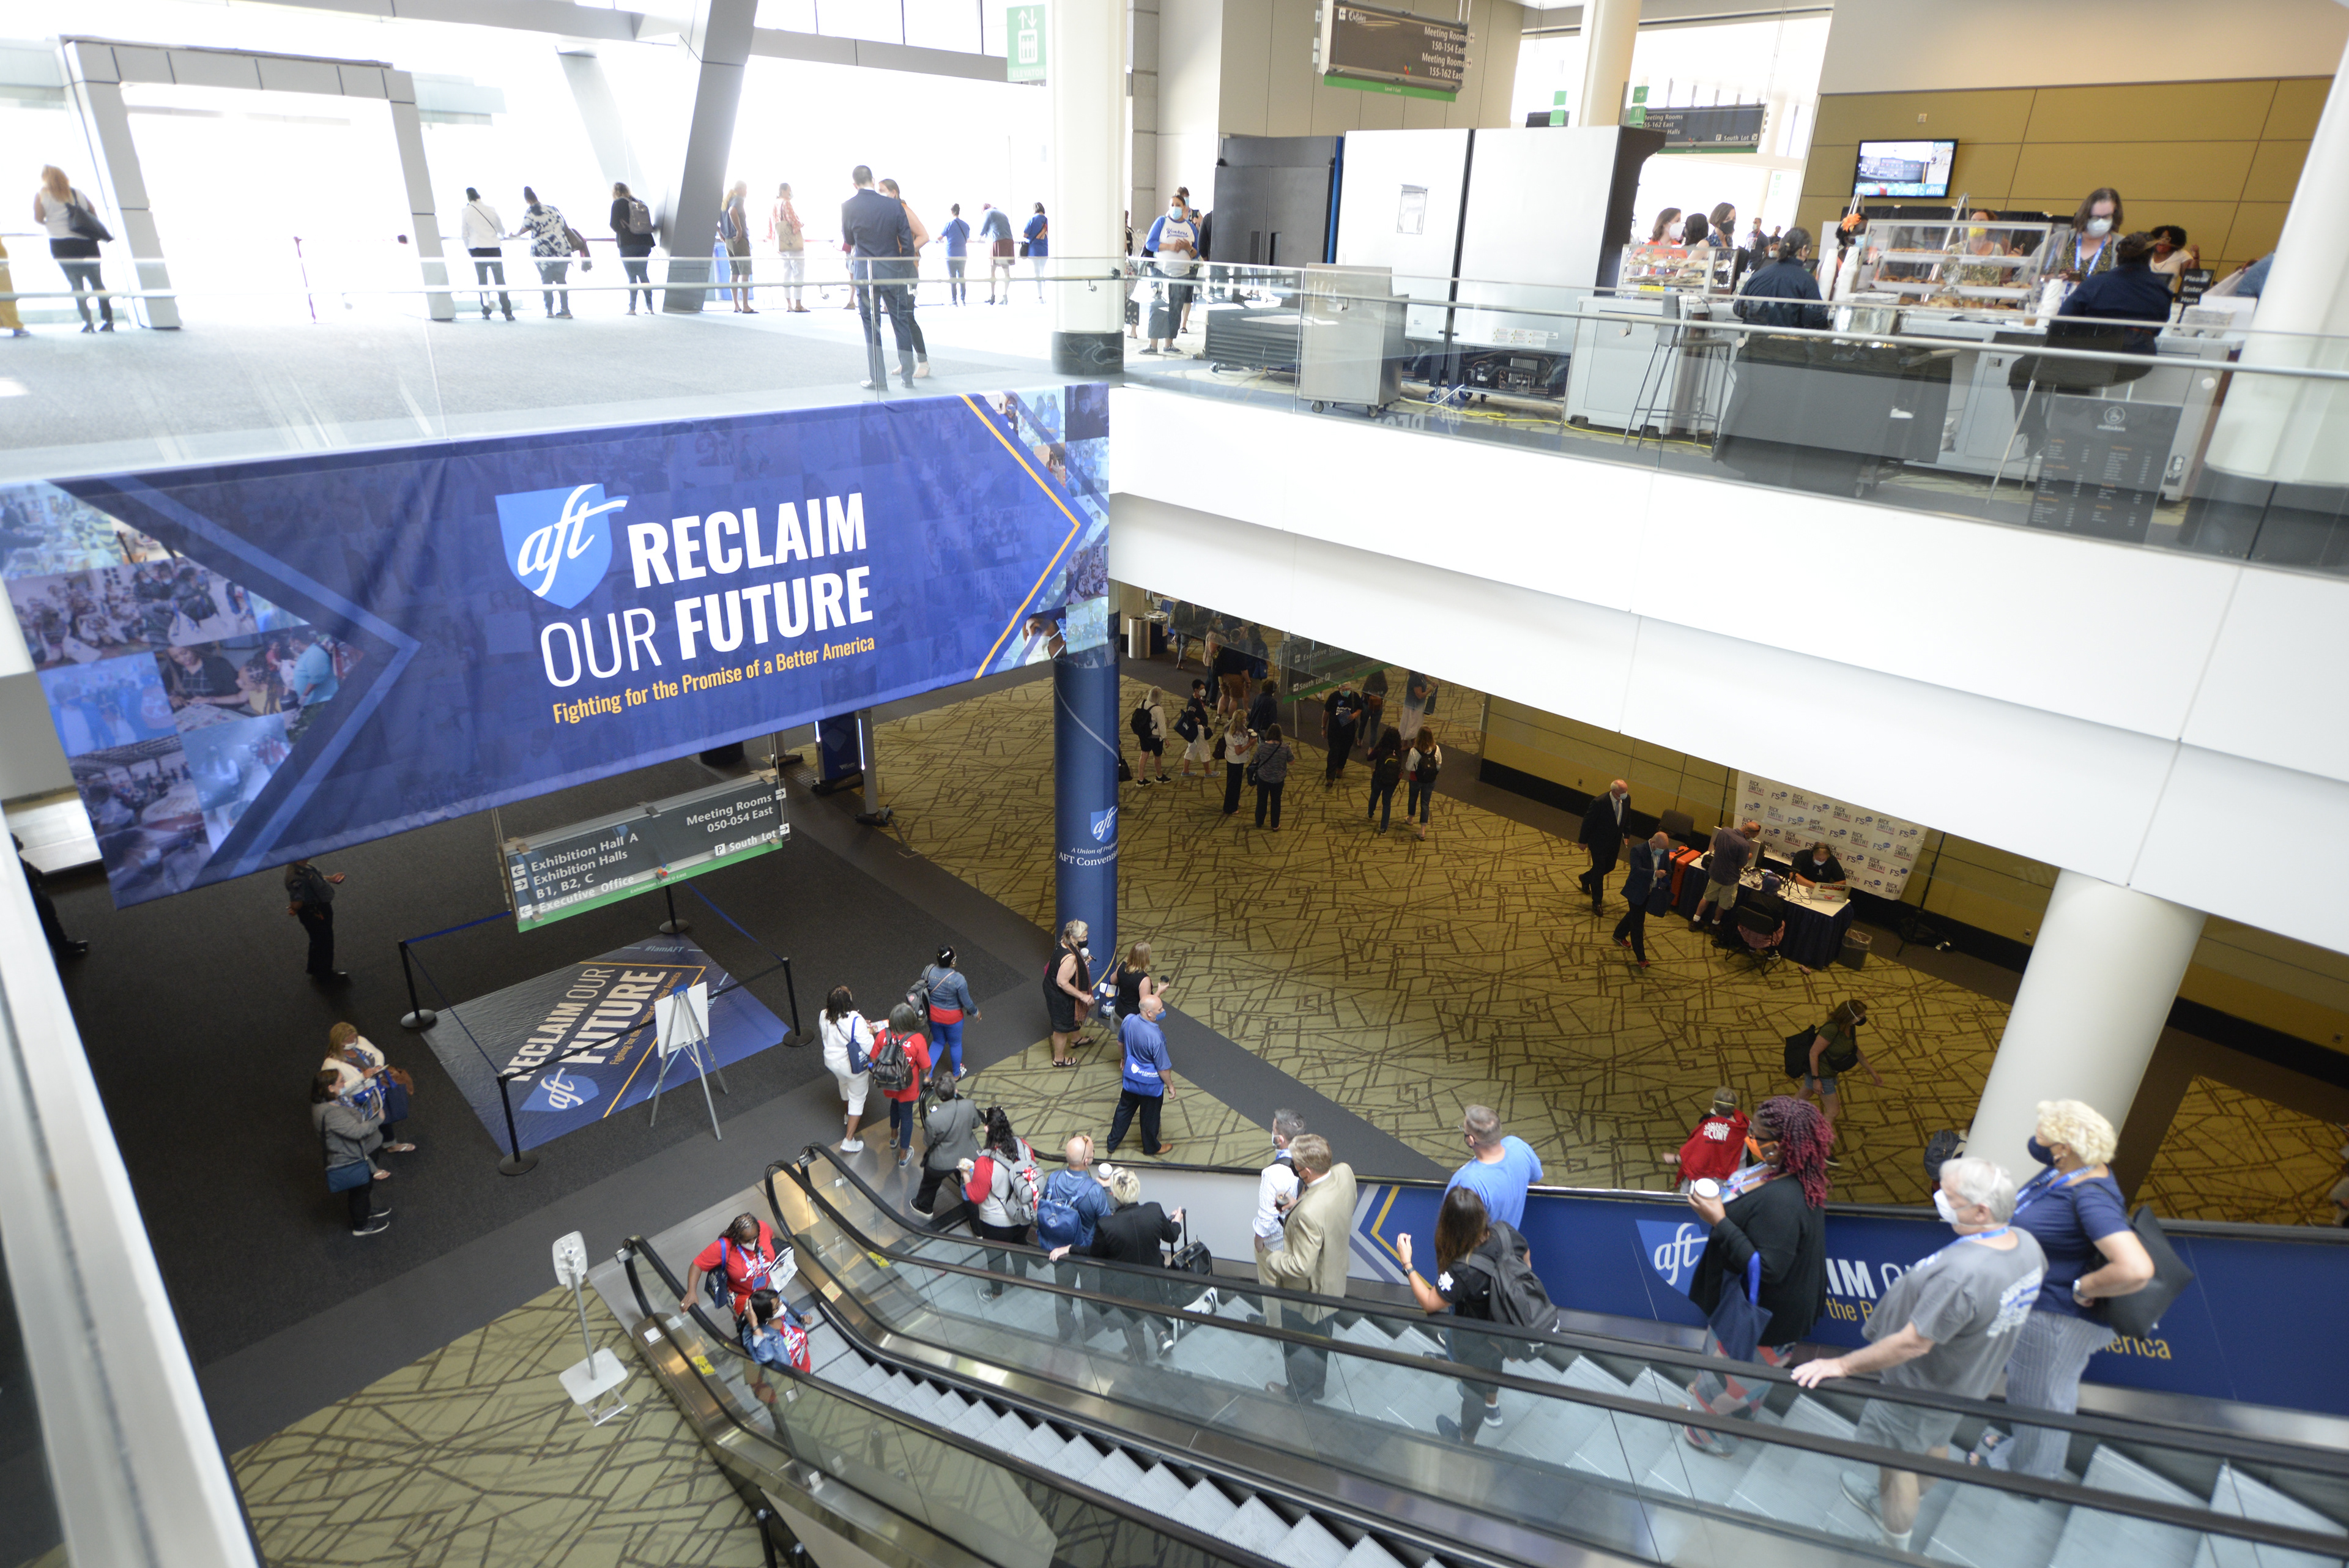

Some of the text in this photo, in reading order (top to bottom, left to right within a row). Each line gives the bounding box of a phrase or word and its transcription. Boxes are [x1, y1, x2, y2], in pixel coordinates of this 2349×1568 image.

[1425, 26, 1467, 42] Meeting Rooms
[1432, 40, 1466, 55] 150-154 East
[1422, 52, 1464, 68] Meeting Rooms
[1013, 69, 1044, 78] ELEVATOR
[1430, 66, 1463, 80] 155-162 East
[518, 483, 628, 597] aft
[628, 492, 866, 589] RECLAIM
[541, 566, 873, 687] OUR FUTURE
[1303, 648, 1327, 661] Executive
[553, 637, 875, 724] Fighting for the Promise of a Better America
[1299, 680, 1314, 690] South
[686, 795, 772, 826] Meeting Rooms
[707, 806, 773, 833] 050-054 East
[1093, 805, 1118, 840] aft
[1877, 823, 1892, 831] SMITH
[729, 836, 757, 852] South
[761, 830, 776, 841] Lot
[1784, 836, 1799, 844] SMITH
[1850, 836, 1866, 845] SMITH
[531, 833, 639, 872] Exhibition Hall A
[1059, 852, 1075, 864] AFT
[1894, 849, 1910, 858] SMITH
[533, 850, 628, 886] Exhibition Halls
[1868, 862, 1883, 871] SMITH
[536, 873, 594, 899] B1, B2, C
[538, 877, 634, 912] Executive Office
[630, 882, 656, 894] Exhibition
[503, 968, 615, 1082] RECLAIM OUR
[558, 970, 667, 1064] FUTURE
[609, 1045, 633, 1065] Fighting
[663, 972, 682, 989] America
[1654, 1222, 1709, 1286] aft
[1826, 1298, 1858, 1321] the
[2102, 1336, 2172, 1359] erica
